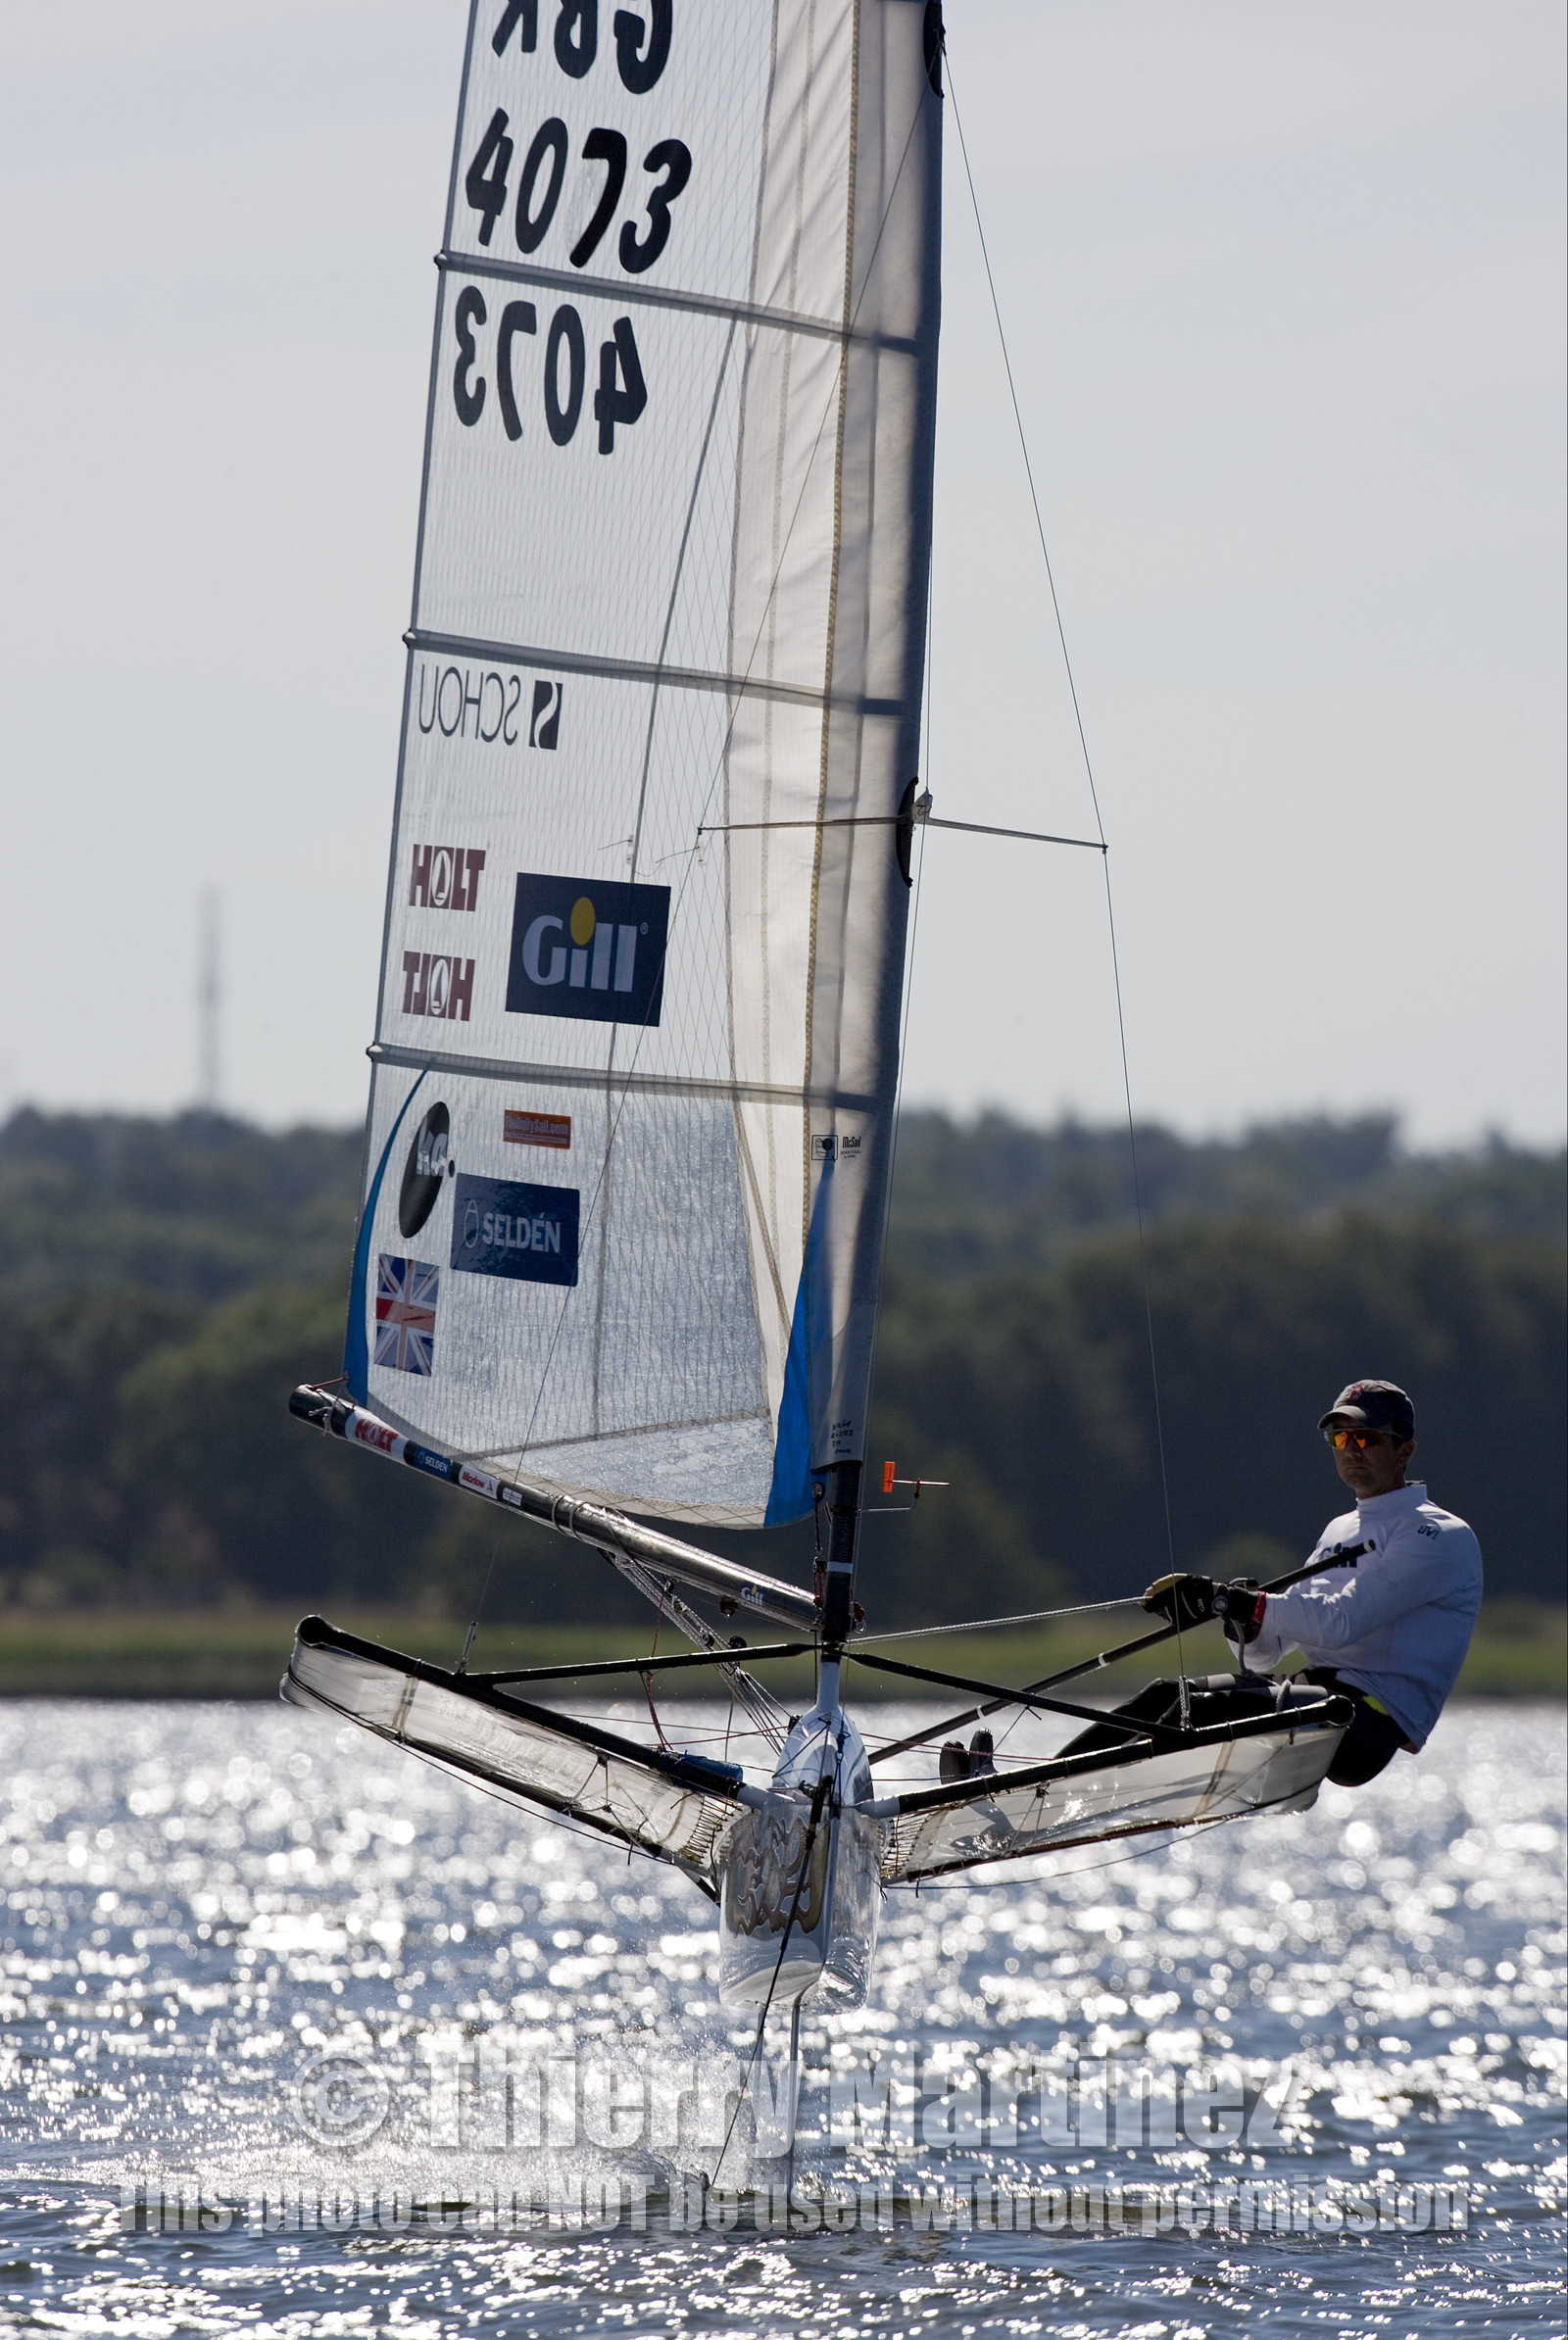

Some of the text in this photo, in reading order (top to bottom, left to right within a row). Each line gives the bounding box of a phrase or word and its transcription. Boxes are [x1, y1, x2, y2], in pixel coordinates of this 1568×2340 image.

[466, 107, 692, 274] 4073
[409, 844, 486, 912] HOLT
[482, 1212, 561, 1253] SELDÉN
[355, 1418, 400, 1452] HOLT
[741, 1584, 763, 1606] Gill
